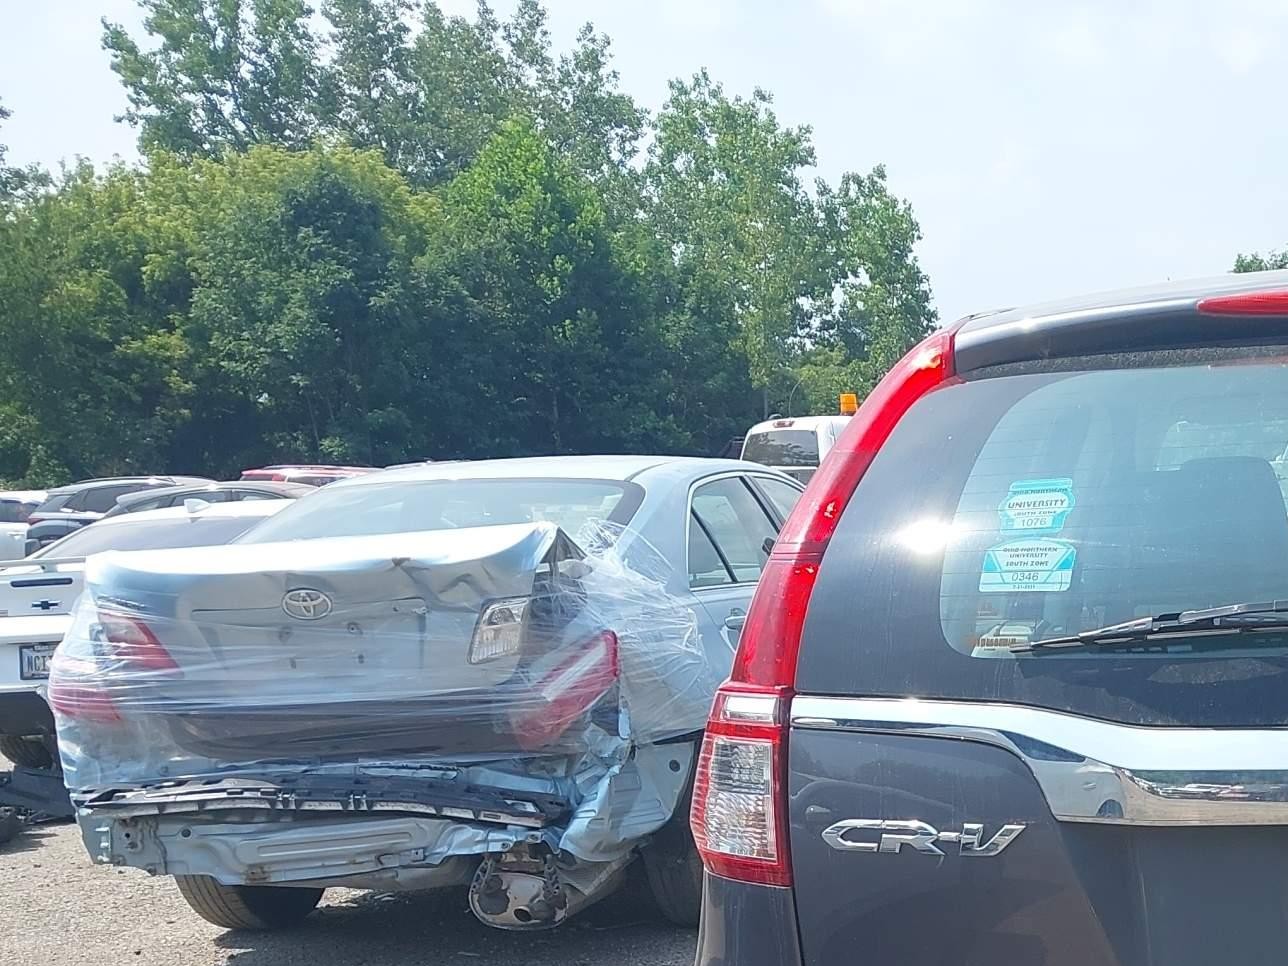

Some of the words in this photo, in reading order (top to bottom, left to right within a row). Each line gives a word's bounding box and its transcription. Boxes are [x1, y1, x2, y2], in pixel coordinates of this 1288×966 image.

[1008, 499, 1066, 509] UNIVERSITY
[1021, 517, 1047, 527] 1076
[1011, 572, 1039, 582] 0346
[821, 818, 1027, 857] CR-V
